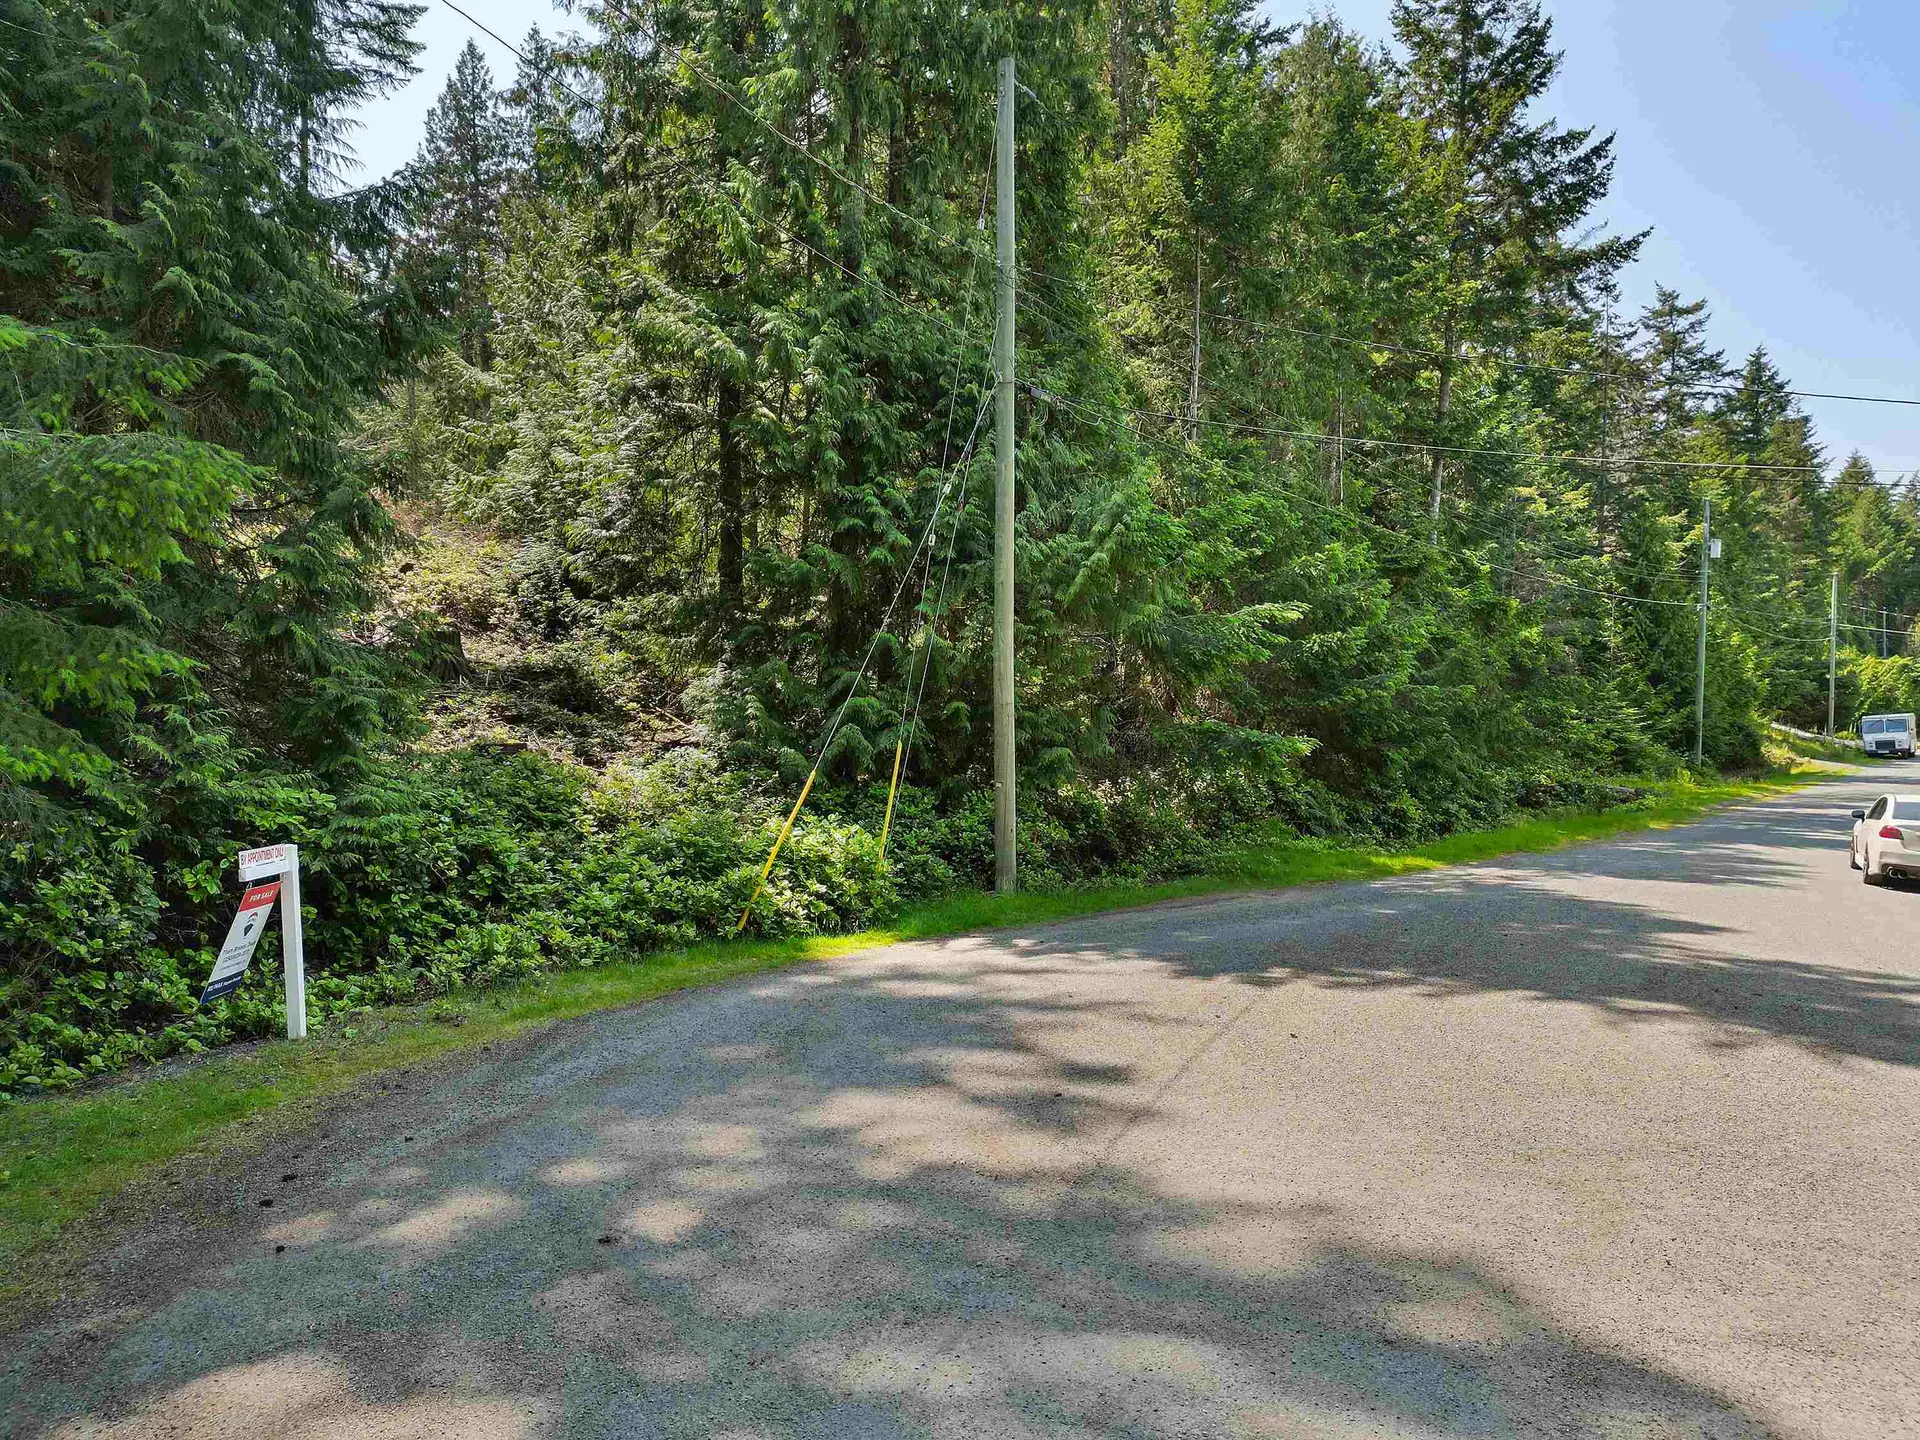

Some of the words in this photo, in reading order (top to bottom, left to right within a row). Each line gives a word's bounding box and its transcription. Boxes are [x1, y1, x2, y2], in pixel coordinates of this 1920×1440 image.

[247, 848, 275, 864] APPOINTMENT
[250, 894, 261, 902] FOR
[261, 891, 274, 899] SALE
